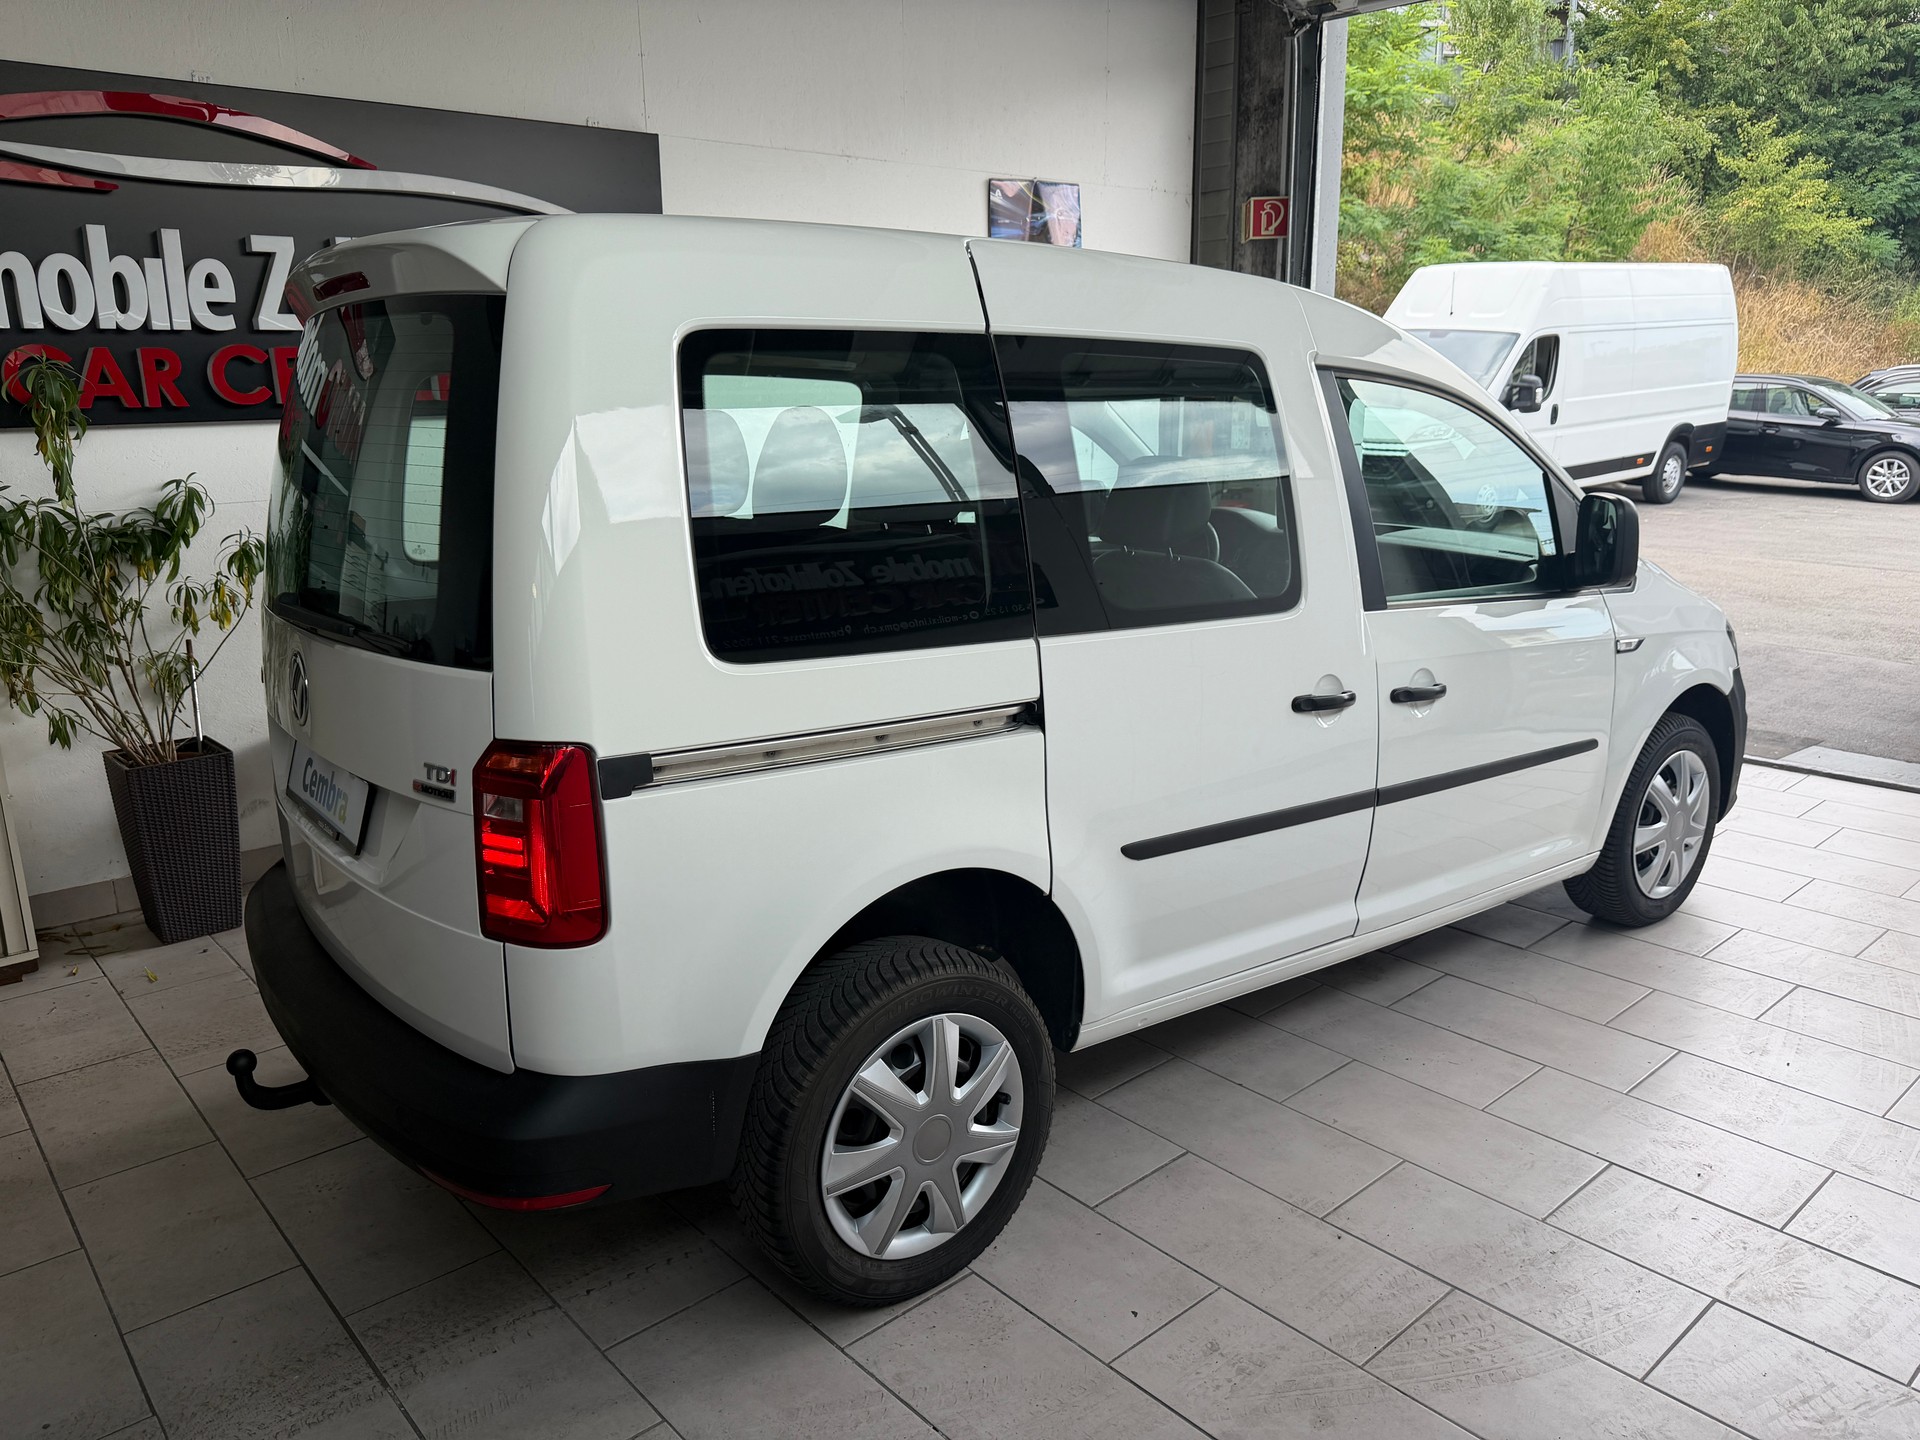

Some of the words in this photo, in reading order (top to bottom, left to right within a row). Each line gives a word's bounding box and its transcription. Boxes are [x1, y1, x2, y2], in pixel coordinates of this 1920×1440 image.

[1, 344, 190, 409] CAR
[302, 757, 349, 825] Cembra
[424, 762, 457, 787] TDI
